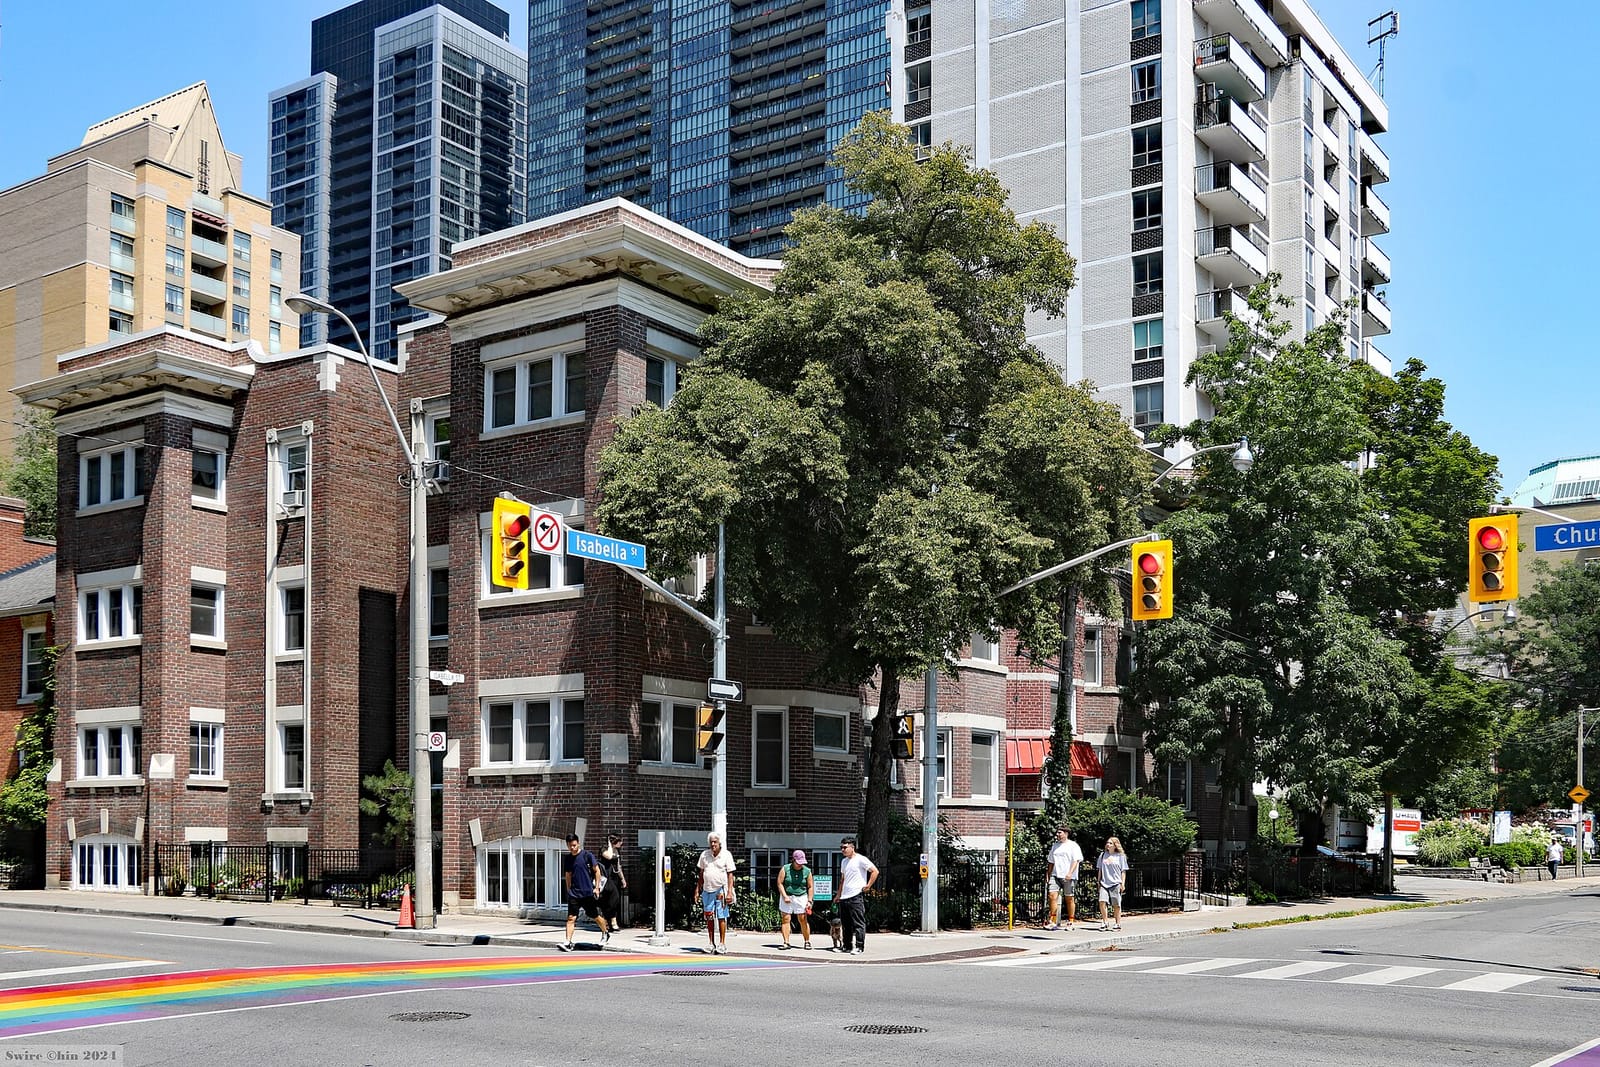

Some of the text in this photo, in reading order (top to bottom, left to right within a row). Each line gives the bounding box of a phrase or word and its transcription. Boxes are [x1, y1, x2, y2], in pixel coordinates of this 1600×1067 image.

[1555, 526, 1600, 545] Chu
[576, 535, 638, 560] Isabella St
